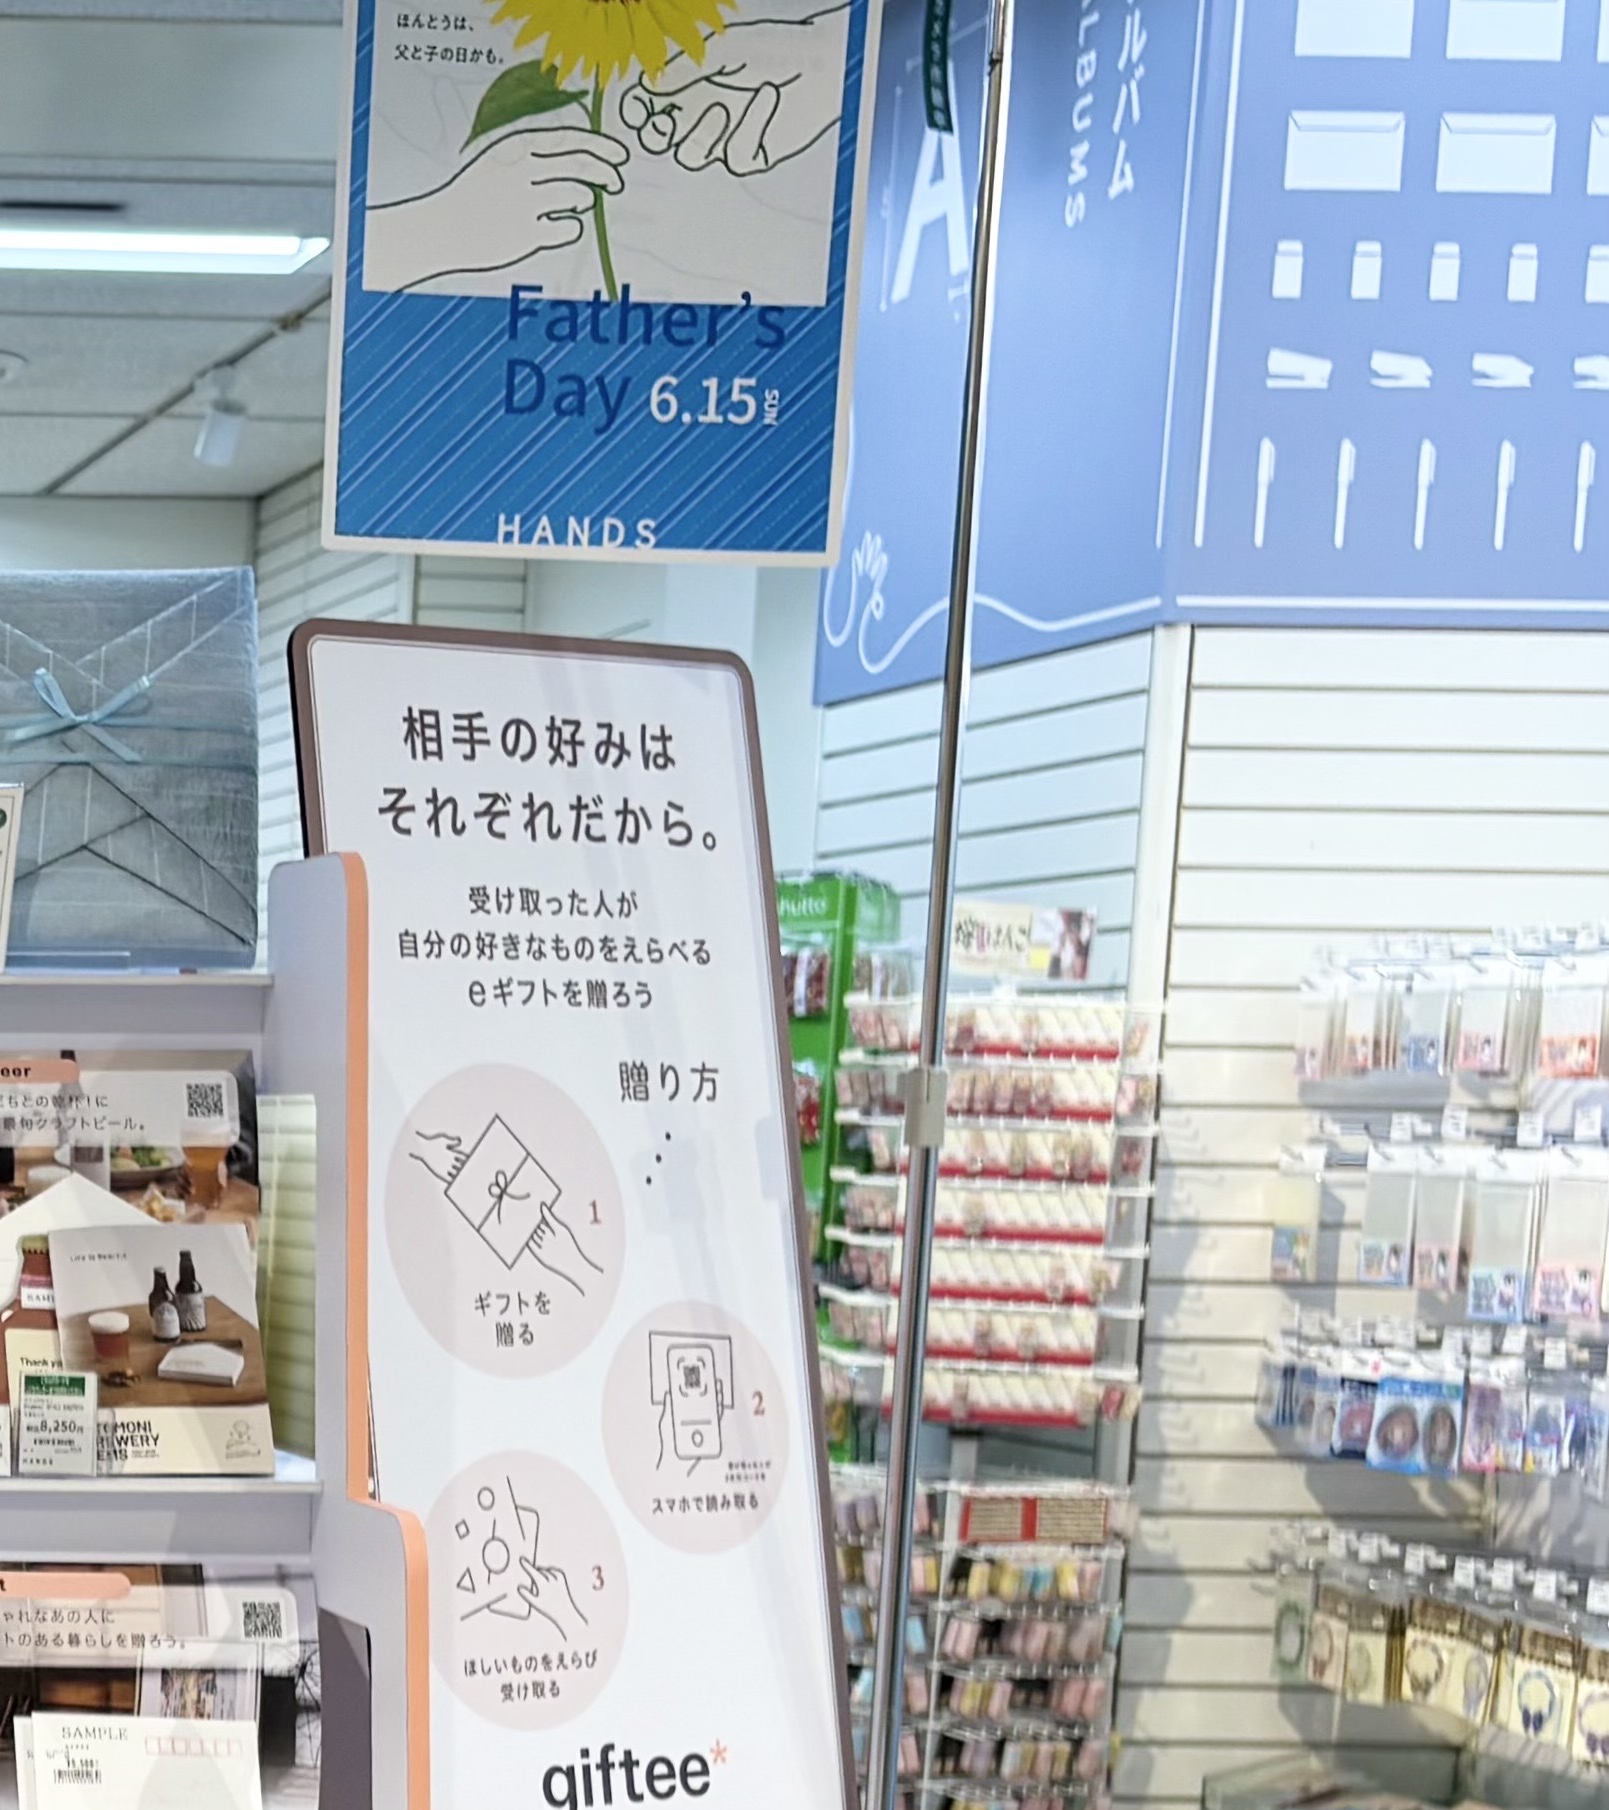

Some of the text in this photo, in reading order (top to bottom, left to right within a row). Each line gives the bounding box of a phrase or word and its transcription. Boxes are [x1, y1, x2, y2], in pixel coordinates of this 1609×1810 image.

[397, 13, 475, 32] ほんとうは、
[394, 45, 504, 64] 父と子の日かも。
[1063, 0, 1100, 228] LBUMS
[1107, 0, 1147, 199] ルバム
[507, 283, 787, 350] Father's
[504, 358, 631, 435] Day
[649, 374, 758, 425] 6.15
[496, 513, 657, 549] HANDS
[402, 706, 676, 771] 相手の好みは
[378, 786, 717, 852] それぞれだから。
[468, 885, 638, 919] 受け取った人が
[398, 930, 711, 965] 自分の好きなものをえらべる
[468, 977, 654, 1009] eギフトを贈ろう
[619, 1061, 720, 1103] 贈り方
[588, 1200, 602, 1225] 1
[473, 1289, 553, 1319] ギフトを
[496, 1321, 536, 1347] 贈る
[753, 1391, 766, 1415] 2
[652, 1492, 760, 1516] スマホで読み取る
[590, 1564, 605, 1591] 3
[464, 1649, 599, 1678] ほしいものをえらび
[499, 1678, 561, 1701] 受け取る
[61, 1727, 128, 1741] SAMPLE
